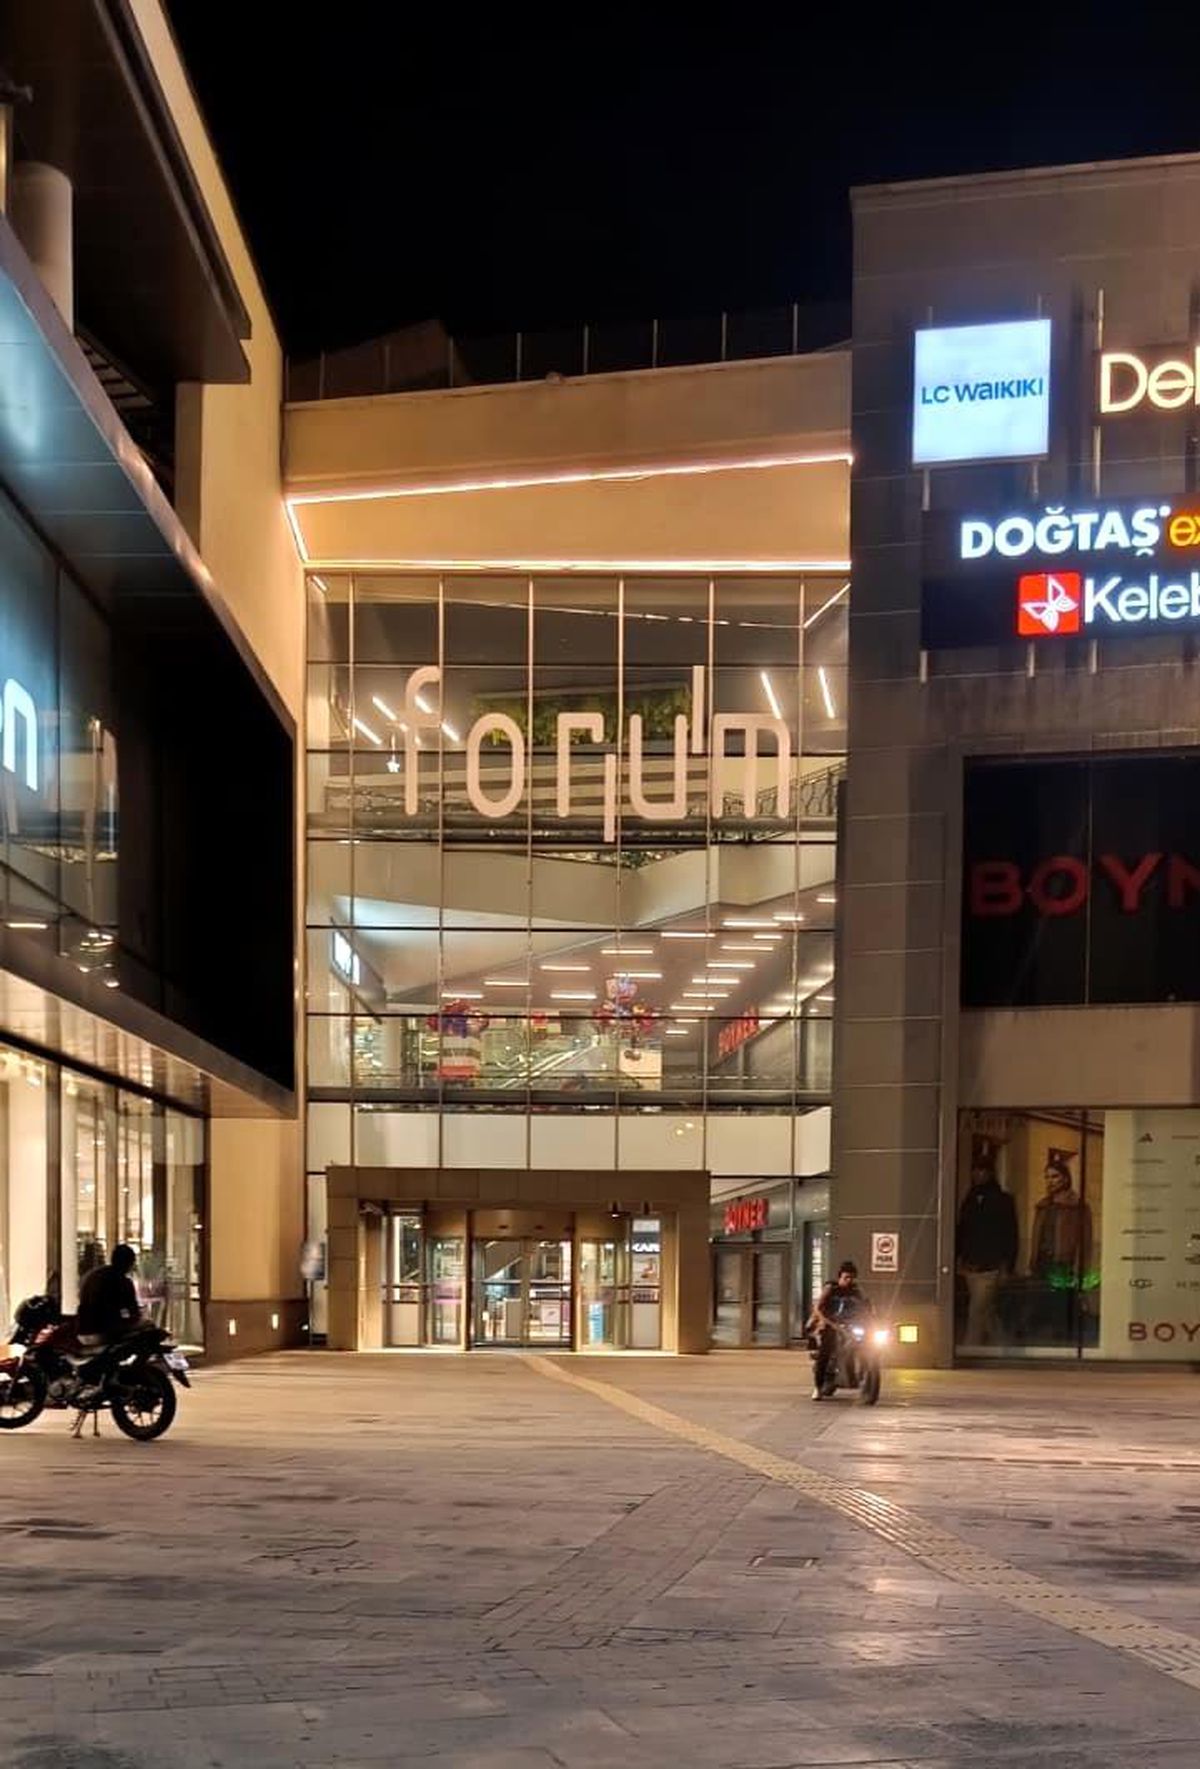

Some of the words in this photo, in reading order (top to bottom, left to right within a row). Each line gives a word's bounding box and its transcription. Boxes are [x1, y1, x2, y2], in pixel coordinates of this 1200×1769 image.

[921, 385, 950, 405] LC
[960, 506, 1160, 559] DOĞTAŞ
[405, 665, 791, 843] forum
[1128, 1322, 1200, 1343] BOY
